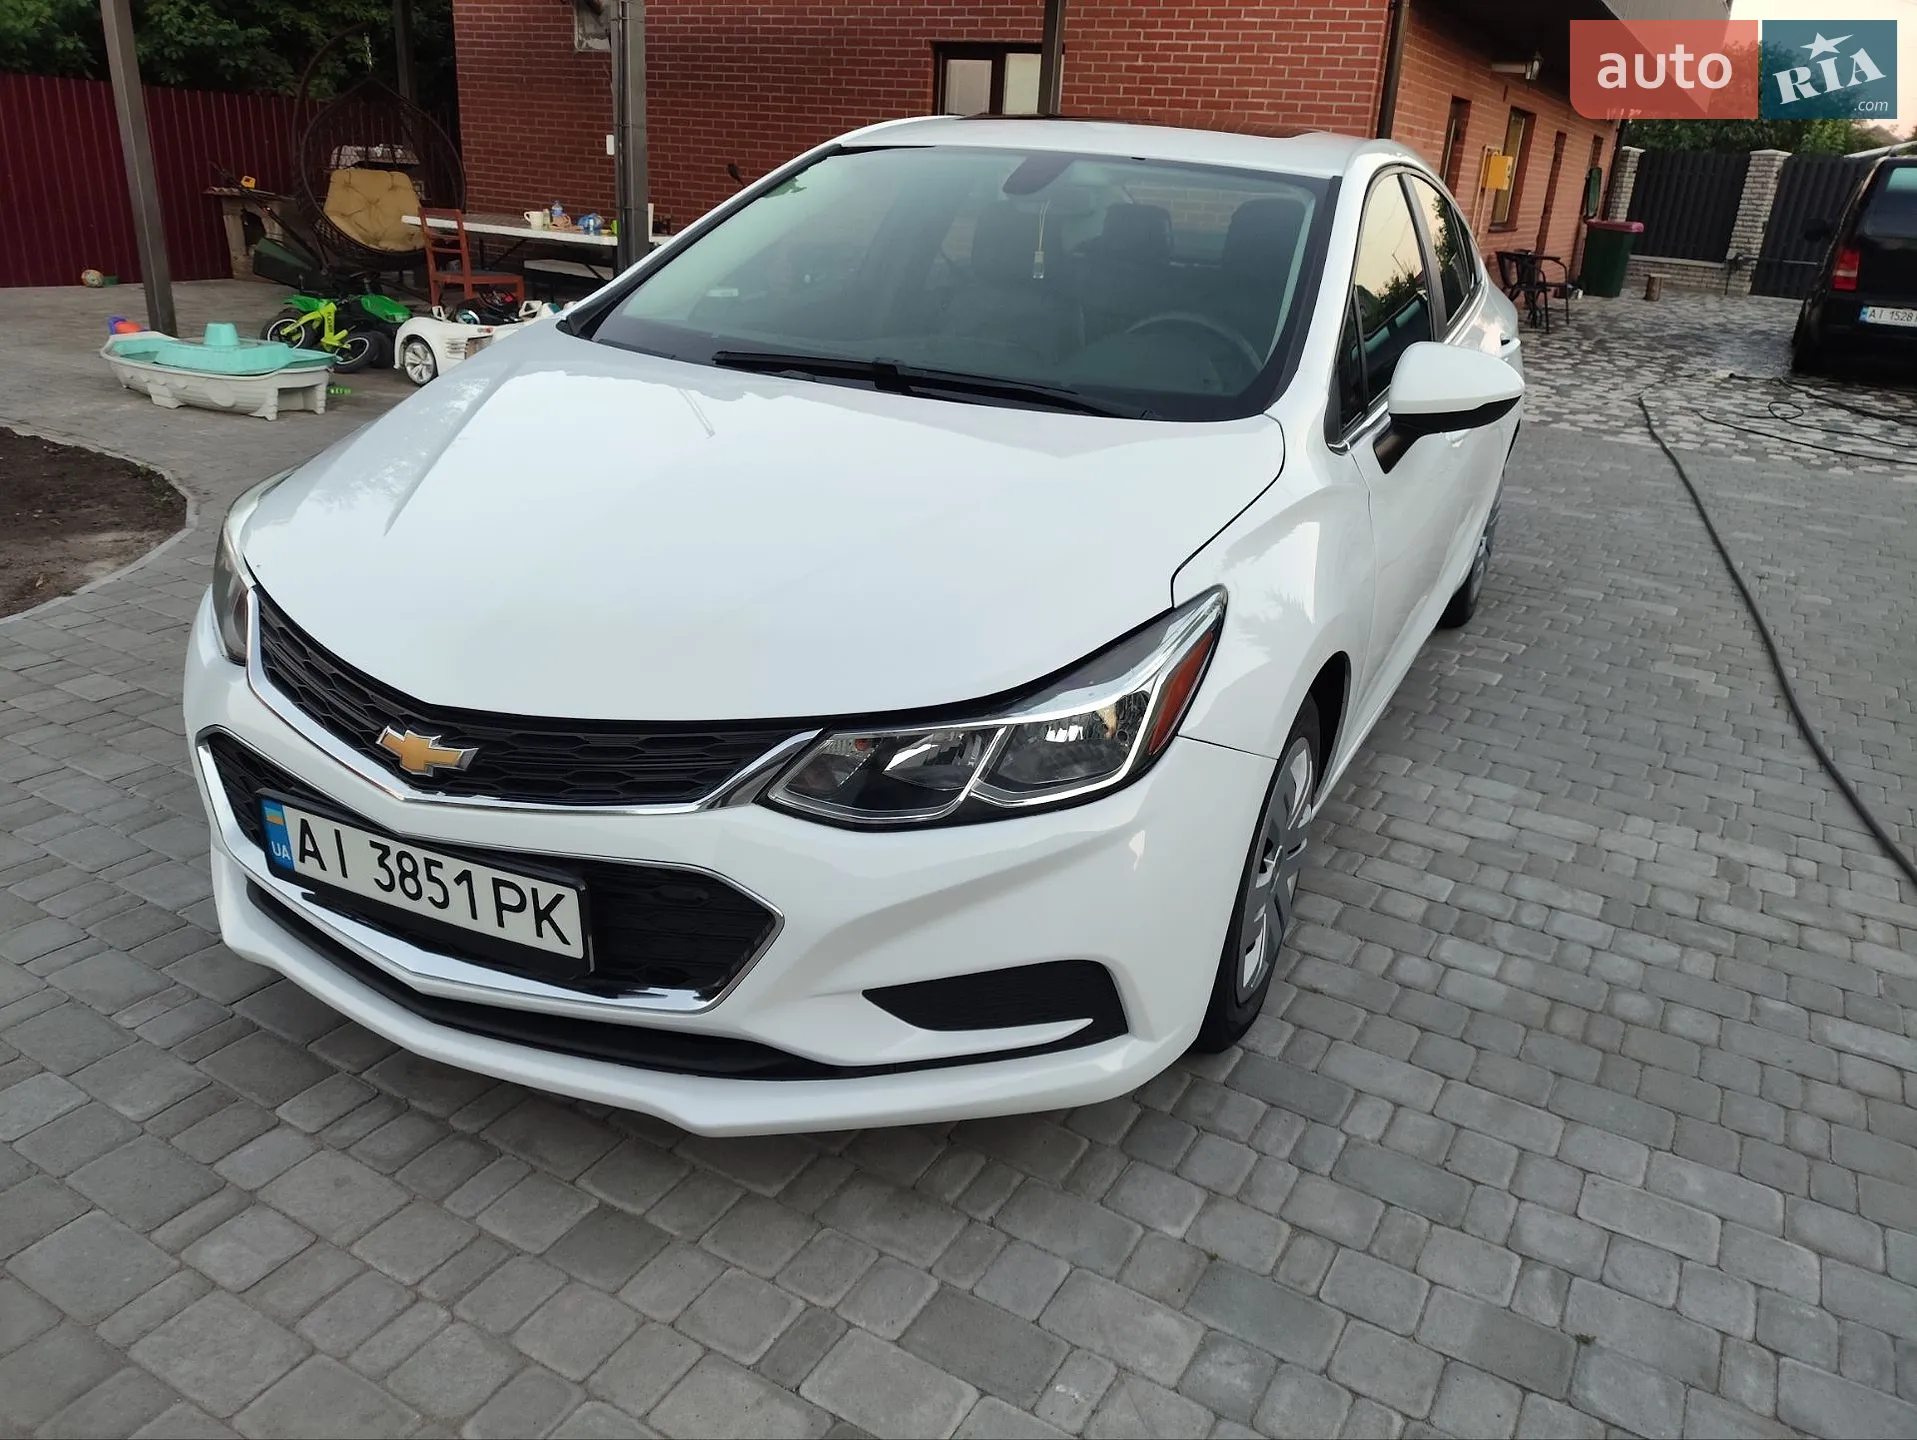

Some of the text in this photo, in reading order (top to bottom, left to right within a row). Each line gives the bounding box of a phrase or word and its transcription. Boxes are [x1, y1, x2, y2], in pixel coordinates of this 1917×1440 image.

[1890, 310, 1914, 322] 1528
[271, 840, 291, 861] UA
[299, 818, 571, 946] AI 3851 PK
